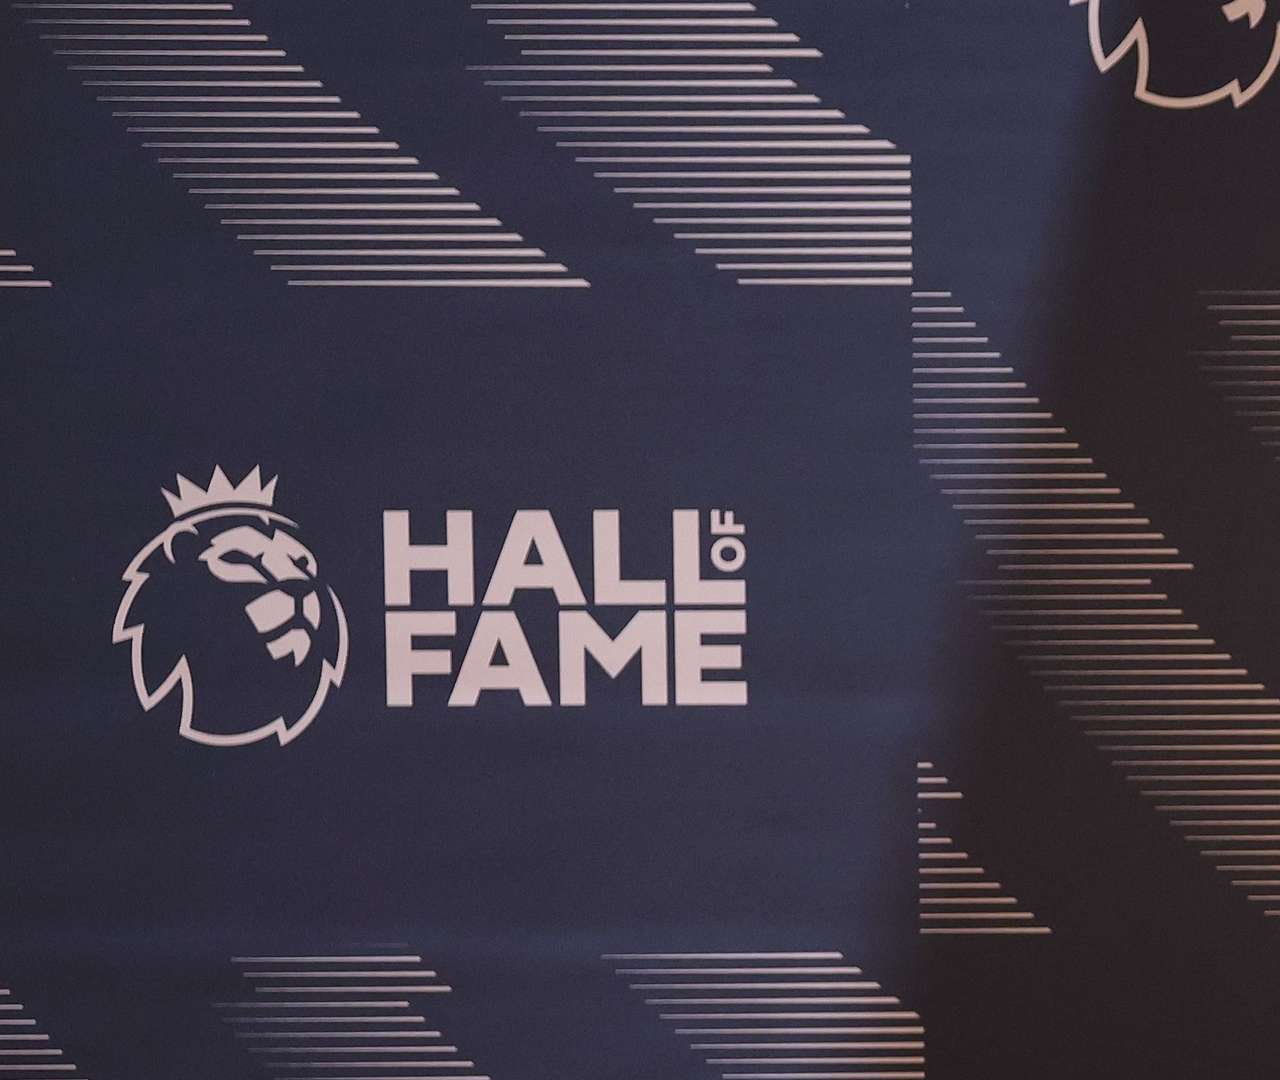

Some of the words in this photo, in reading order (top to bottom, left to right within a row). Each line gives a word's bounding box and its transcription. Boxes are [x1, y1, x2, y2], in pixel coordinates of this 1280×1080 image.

[383, 509, 747, 606] HALL
[710, 509, 747, 572] OF
[385, 609, 748, 707] FAME
